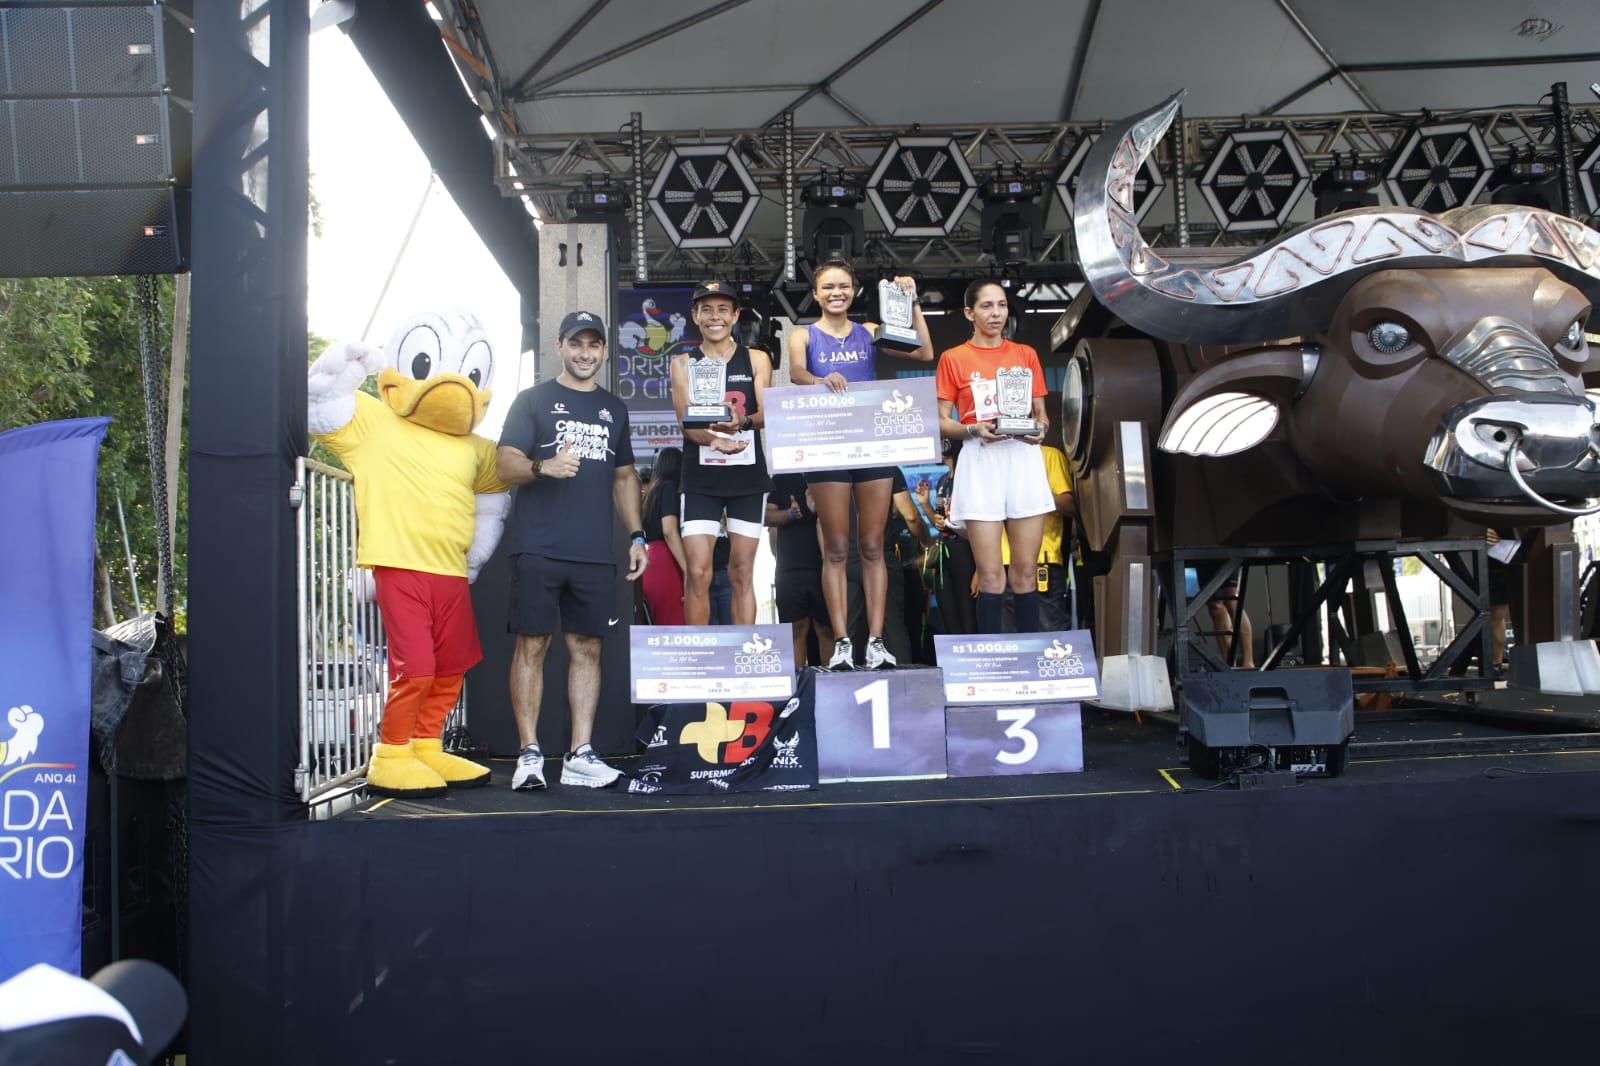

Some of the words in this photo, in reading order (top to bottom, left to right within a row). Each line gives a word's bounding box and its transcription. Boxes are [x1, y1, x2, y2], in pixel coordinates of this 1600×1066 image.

[829, 351, 858, 362] JAM
[619, 355, 671, 376] ORRI
[797, 396, 855, 408] 5.000,00
[874, 413, 923, 426] CORRIDA
[555, 420, 610, 438] CORRIDA
[874, 425, 893, 437] DO
[647, 637, 660, 647] R$
[662, 635, 717, 647] 2.000,00
[952, 645, 965, 654] R$
[967, 643, 1019, 654] 1.000,00
[734, 654, 781, 665] CORRIDA
[1037, 658, 1083, 669] CORRIDA
[735, 664, 752, 674] DO
[1038, 668, 1056, 677] DO
[854, 679, 891, 750] 1
[995, 708, 1039, 765] 3
[773, 757, 799, 765] NIX
[34, 773, 63, 784] ANO
[64, 773, 76, 784] 41
[690, 768, 737, 780] SUPERM
